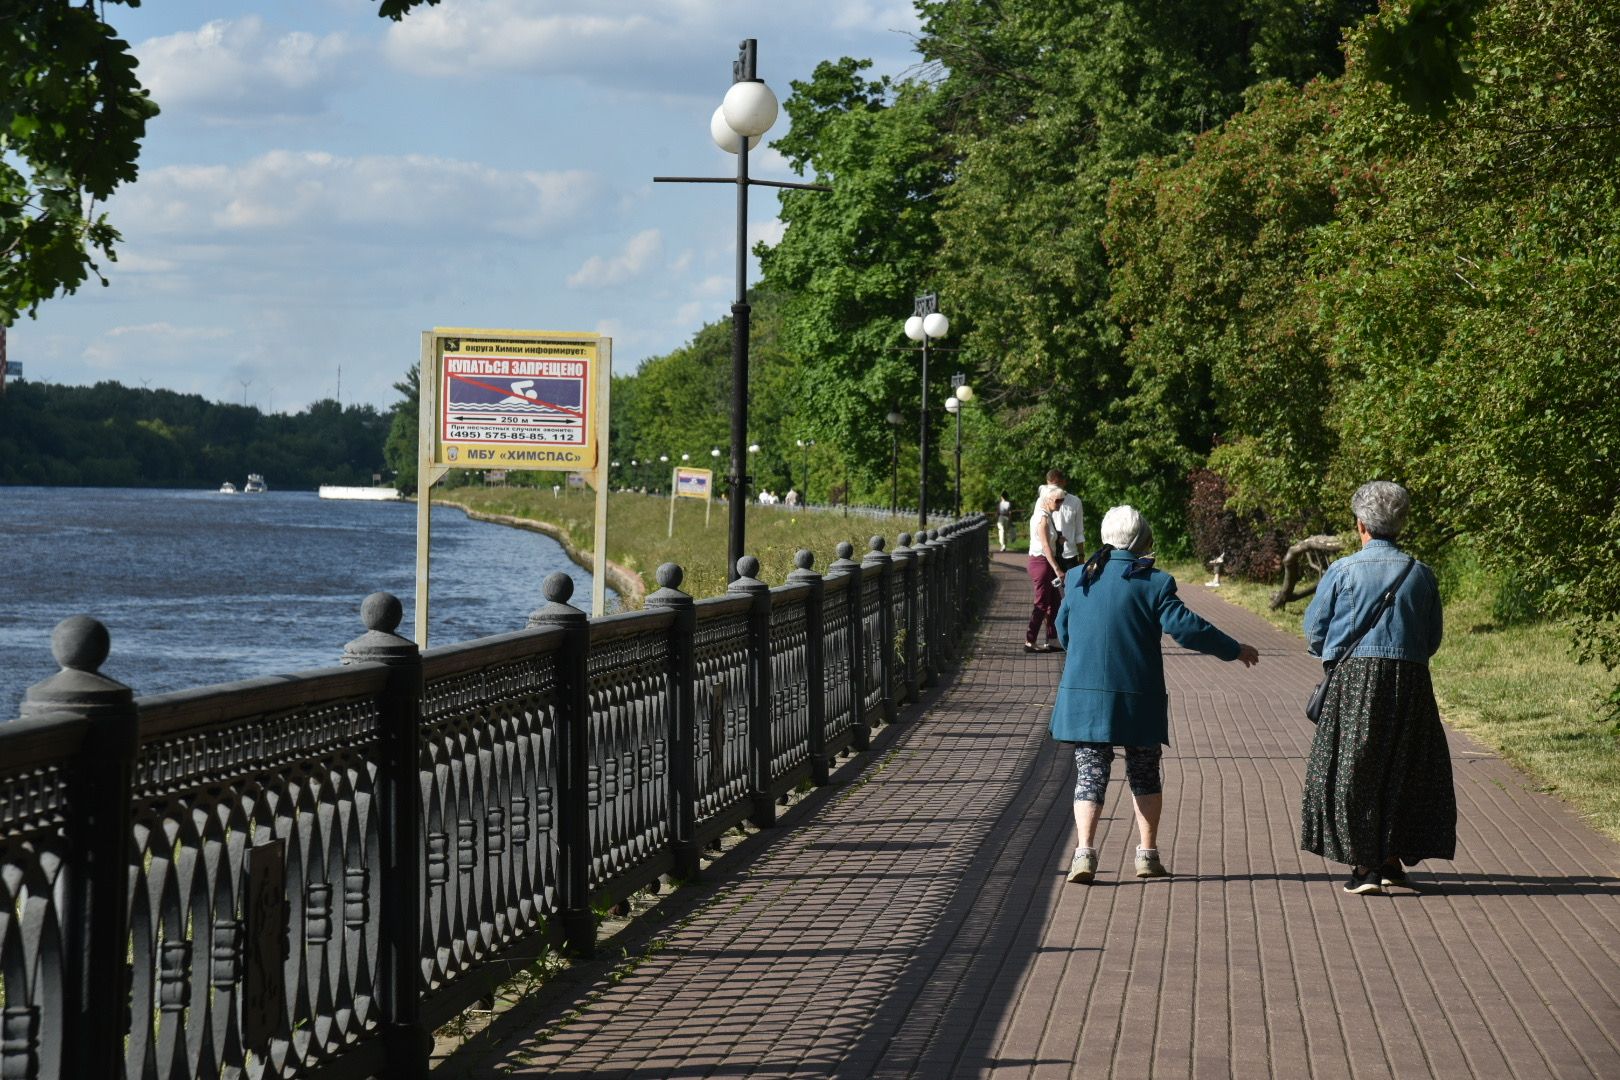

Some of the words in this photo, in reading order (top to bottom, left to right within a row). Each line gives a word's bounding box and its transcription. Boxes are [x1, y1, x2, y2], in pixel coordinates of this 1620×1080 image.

[495, 345, 523, 353] Химки
[525, 347, 587, 355] информирует:
[448, 359, 510, 374] КУПАТЬСЯ
[511, 361, 583, 377] ЗАПРЕЩЕНО
[501, 416, 519, 424] 250
[450, 430, 481, 439] (495)
[552, 433, 575, 441] 112
[467, 449, 496, 460] МБУ
[500, 450, 581, 461] «ХИМСПАС»
